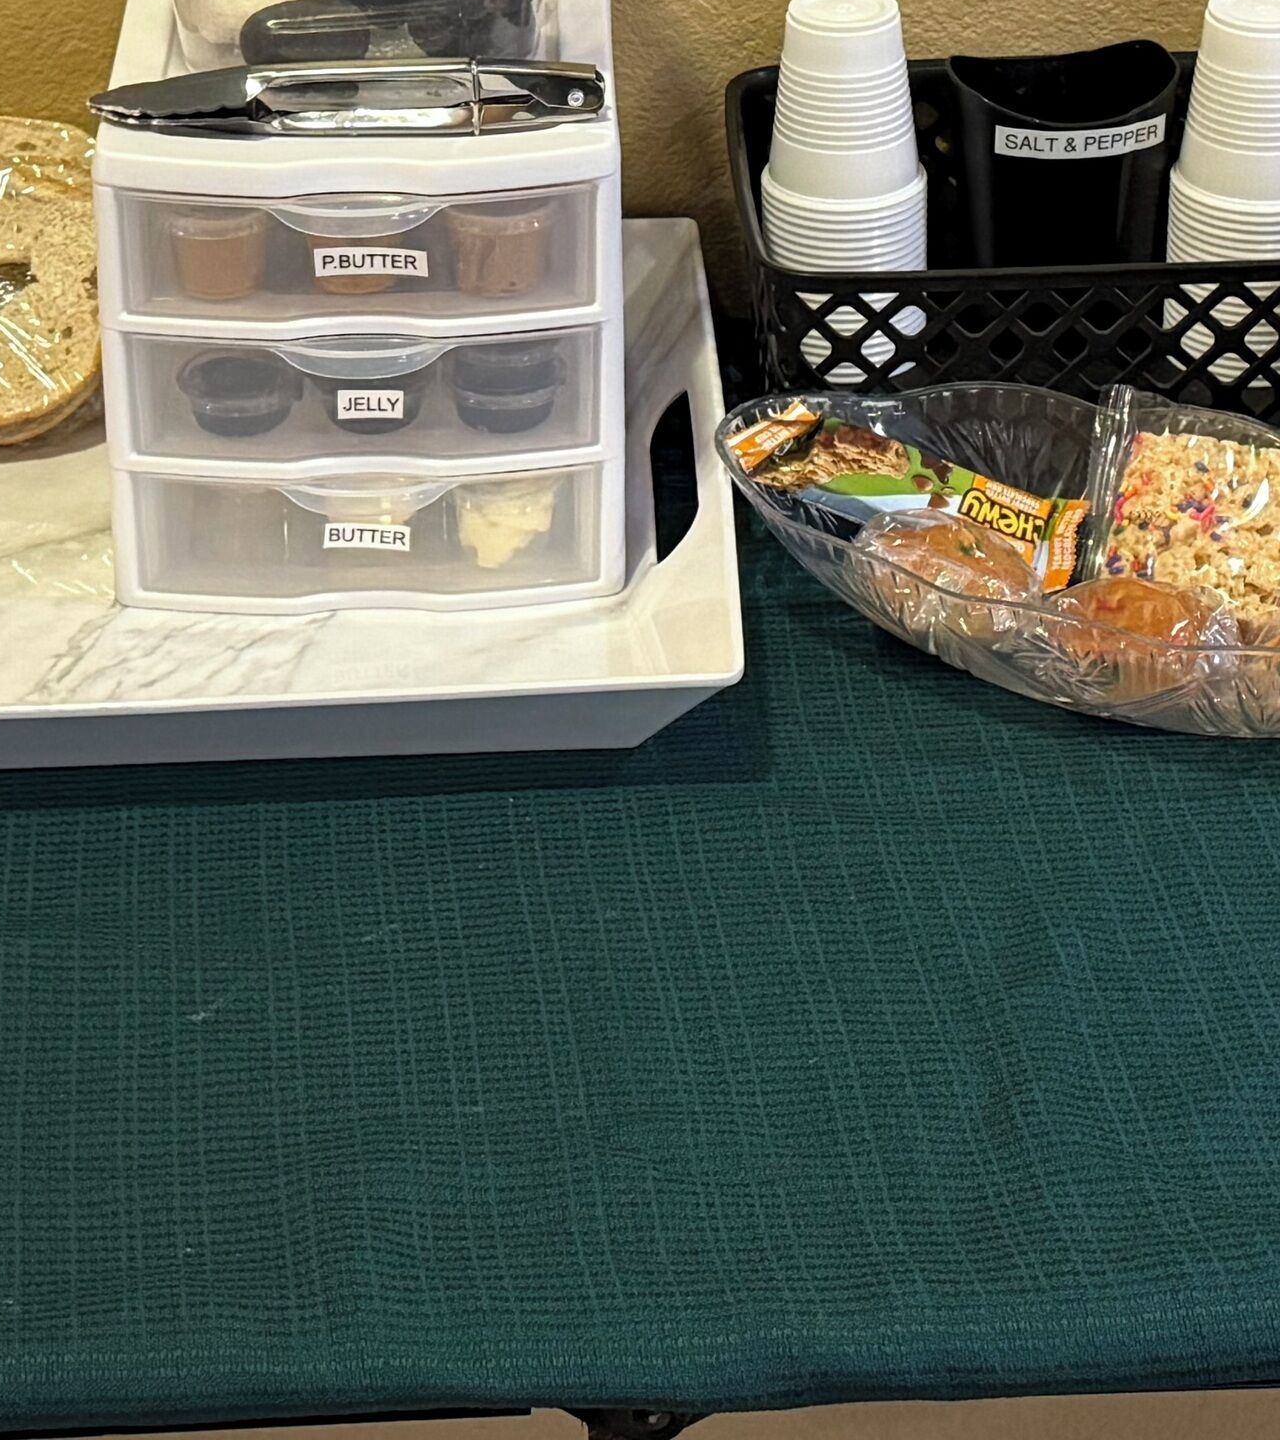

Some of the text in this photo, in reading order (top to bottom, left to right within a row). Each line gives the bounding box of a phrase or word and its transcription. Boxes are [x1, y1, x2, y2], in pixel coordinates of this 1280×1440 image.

[1004, 124, 1158, 153] SALT & PEPPER
[322, 253, 418, 270] P.BUTTER
[343, 396, 400, 412] JELLY
[328, 527, 406, 546] BUTTER
